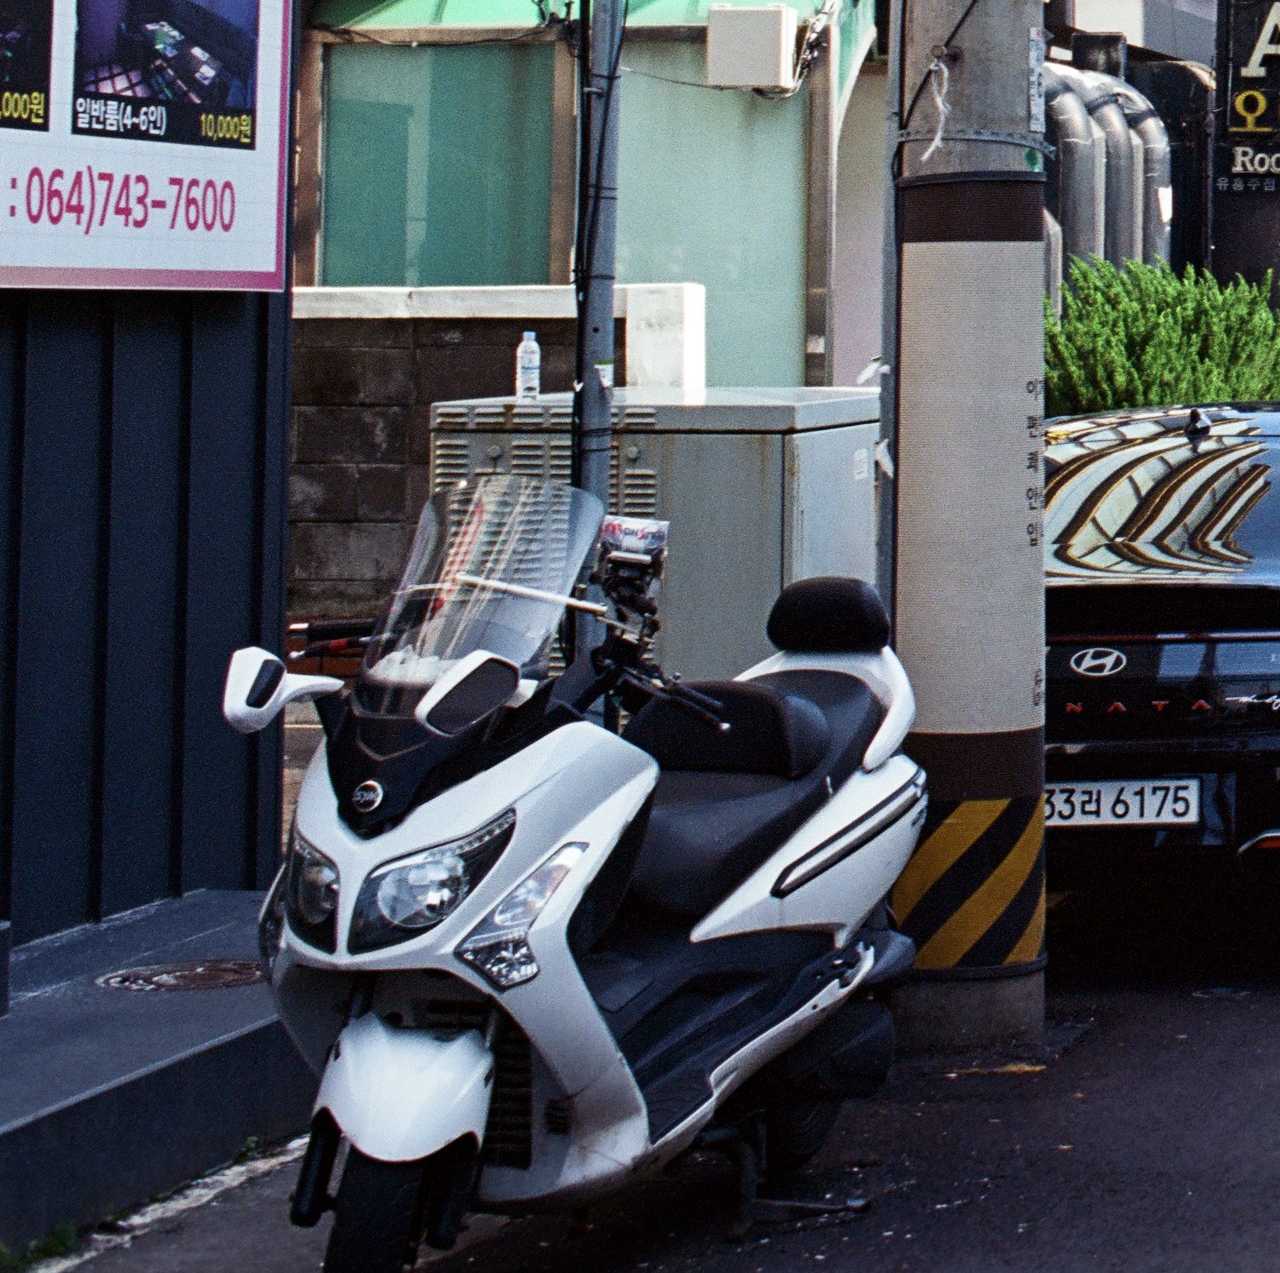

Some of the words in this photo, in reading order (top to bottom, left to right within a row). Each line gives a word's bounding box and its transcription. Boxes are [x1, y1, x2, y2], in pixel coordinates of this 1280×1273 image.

[0, 91, 46, 125] ,000원
[75, 95, 168, 136] 일반룸(4~6인)
[199, 111, 252, 143] 10,000원
[25, 164, 236, 236] 064)743-7600
[1065, 699, 1212, 713] NATA
[1111, 785, 1191, 819] 6175
